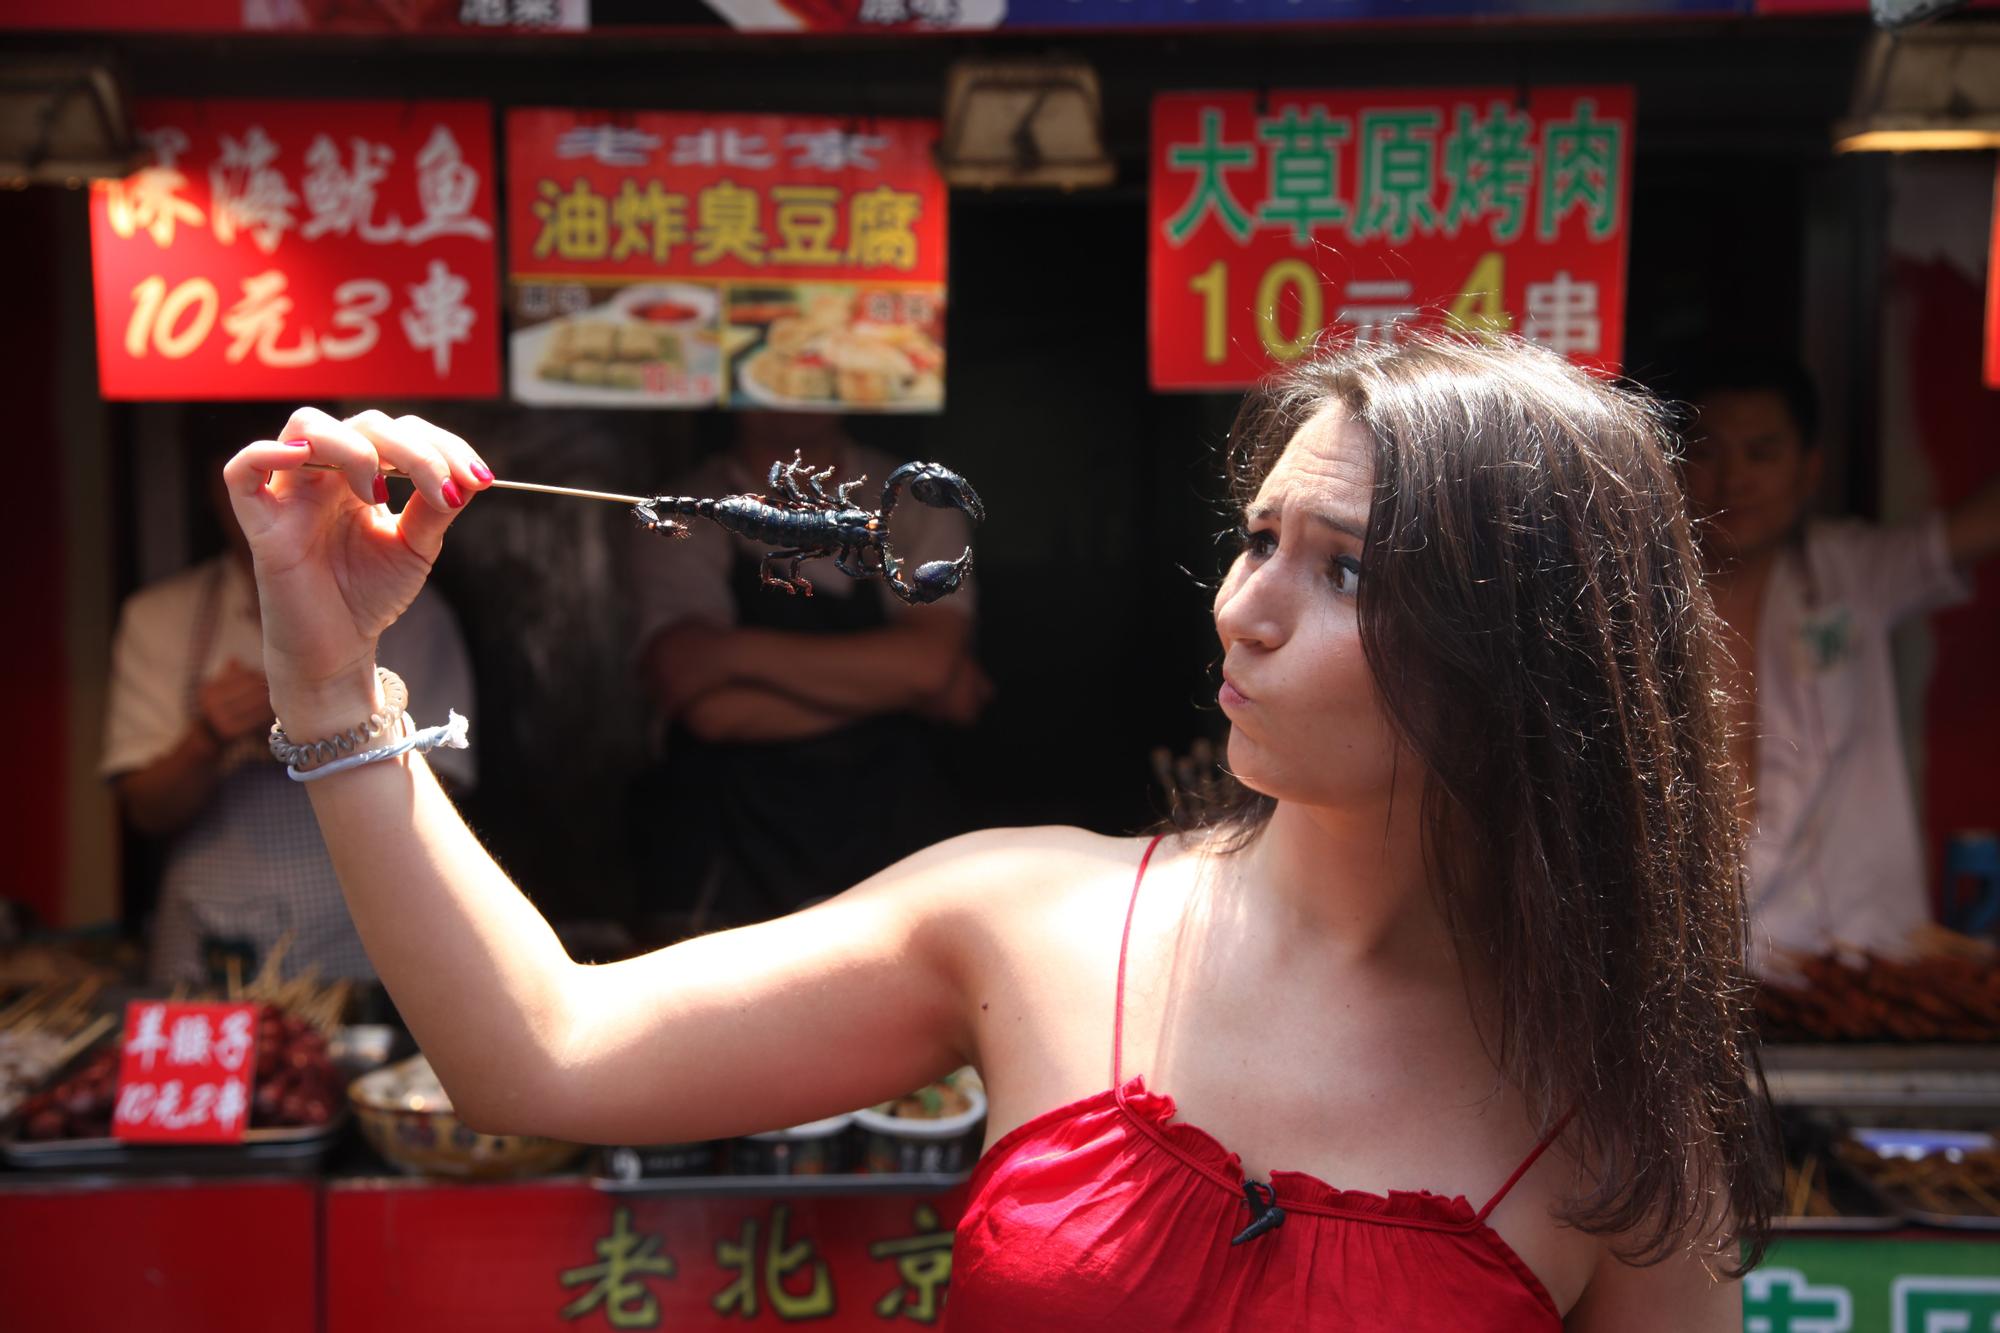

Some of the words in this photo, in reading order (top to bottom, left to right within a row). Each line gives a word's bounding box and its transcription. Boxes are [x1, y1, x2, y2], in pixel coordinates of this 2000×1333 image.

[556, 124, 890, 172] 老北京
[1166, 100, 1624, 241] 大草原烤肉
[533, 176, 922, 271] 油炸臭豆腐
[123, 259, 477, 378] 10元3串
[560, 1205, 954, 1329] 老北京
